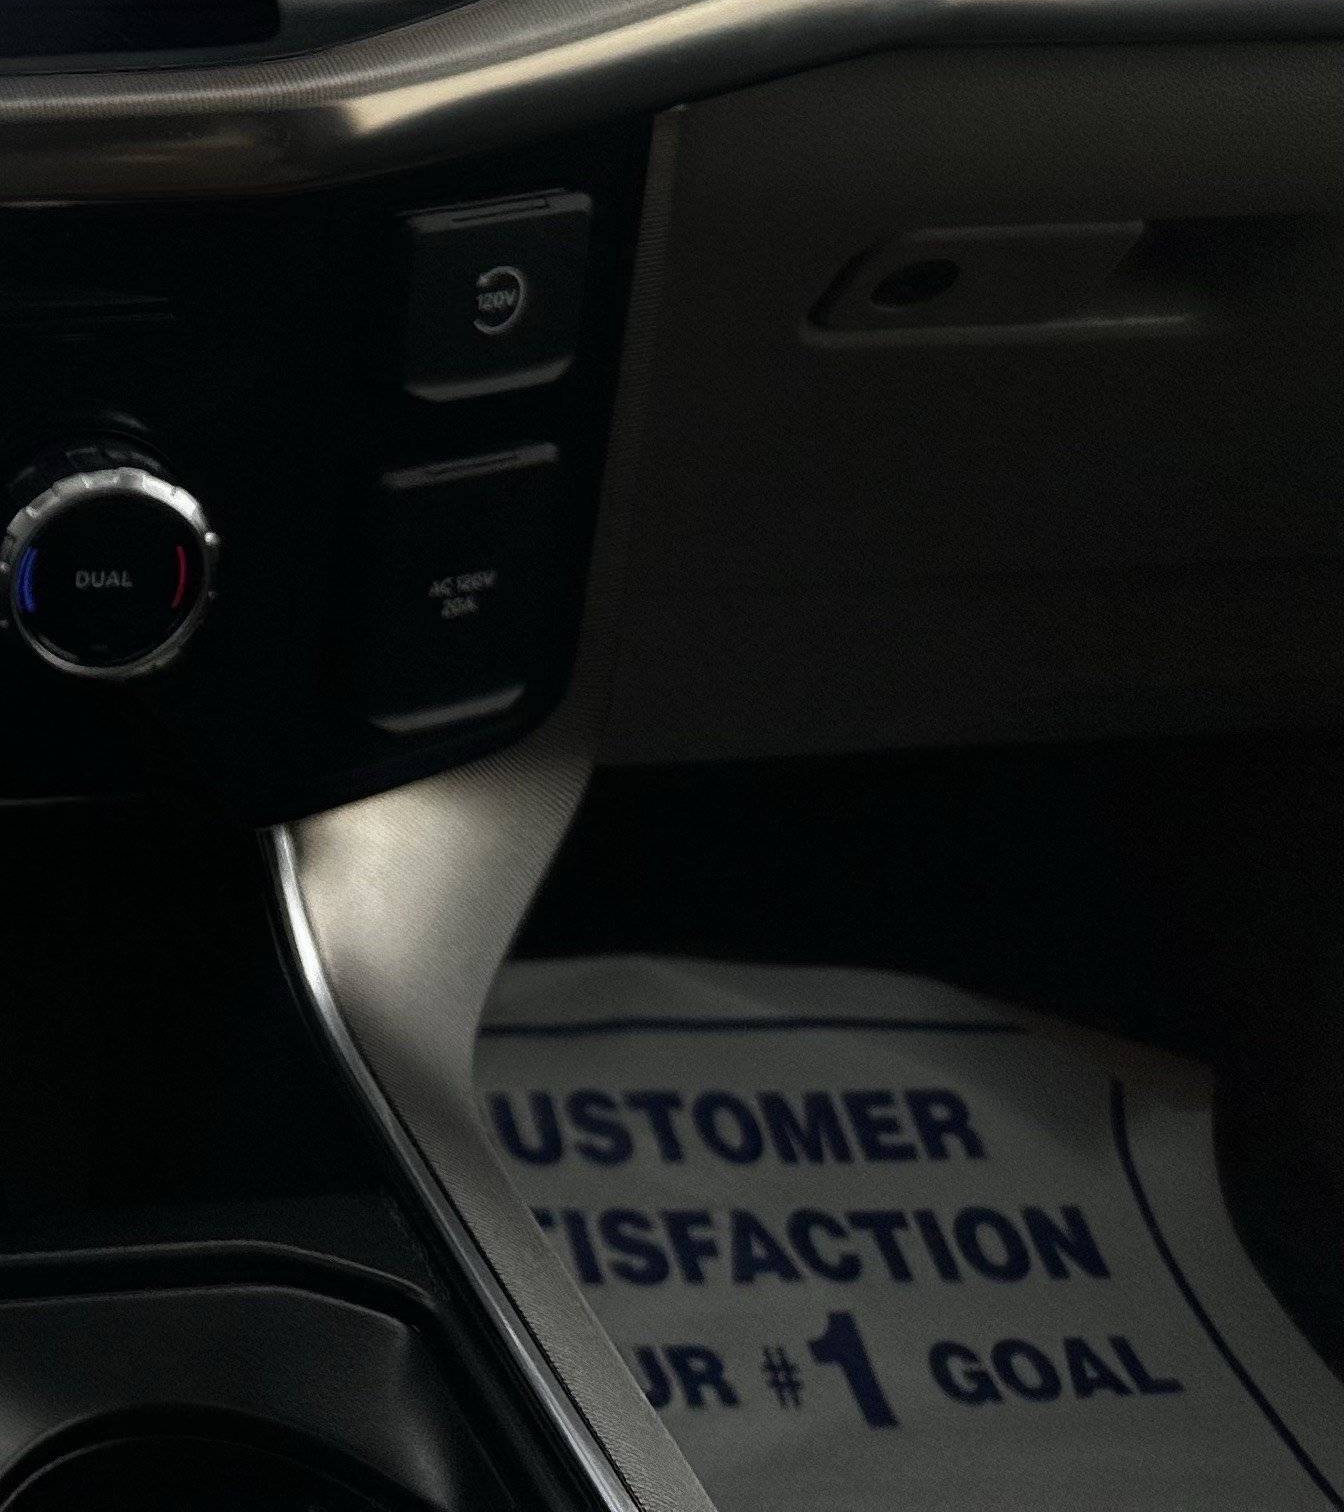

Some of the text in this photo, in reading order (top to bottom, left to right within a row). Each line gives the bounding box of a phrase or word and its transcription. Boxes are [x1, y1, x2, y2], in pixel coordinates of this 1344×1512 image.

[74, 570, 134, 590] DUAL
[529, 1203, 1113, 1286] ISFACTION
[926, 1335, 1186, 1410] GOAL
